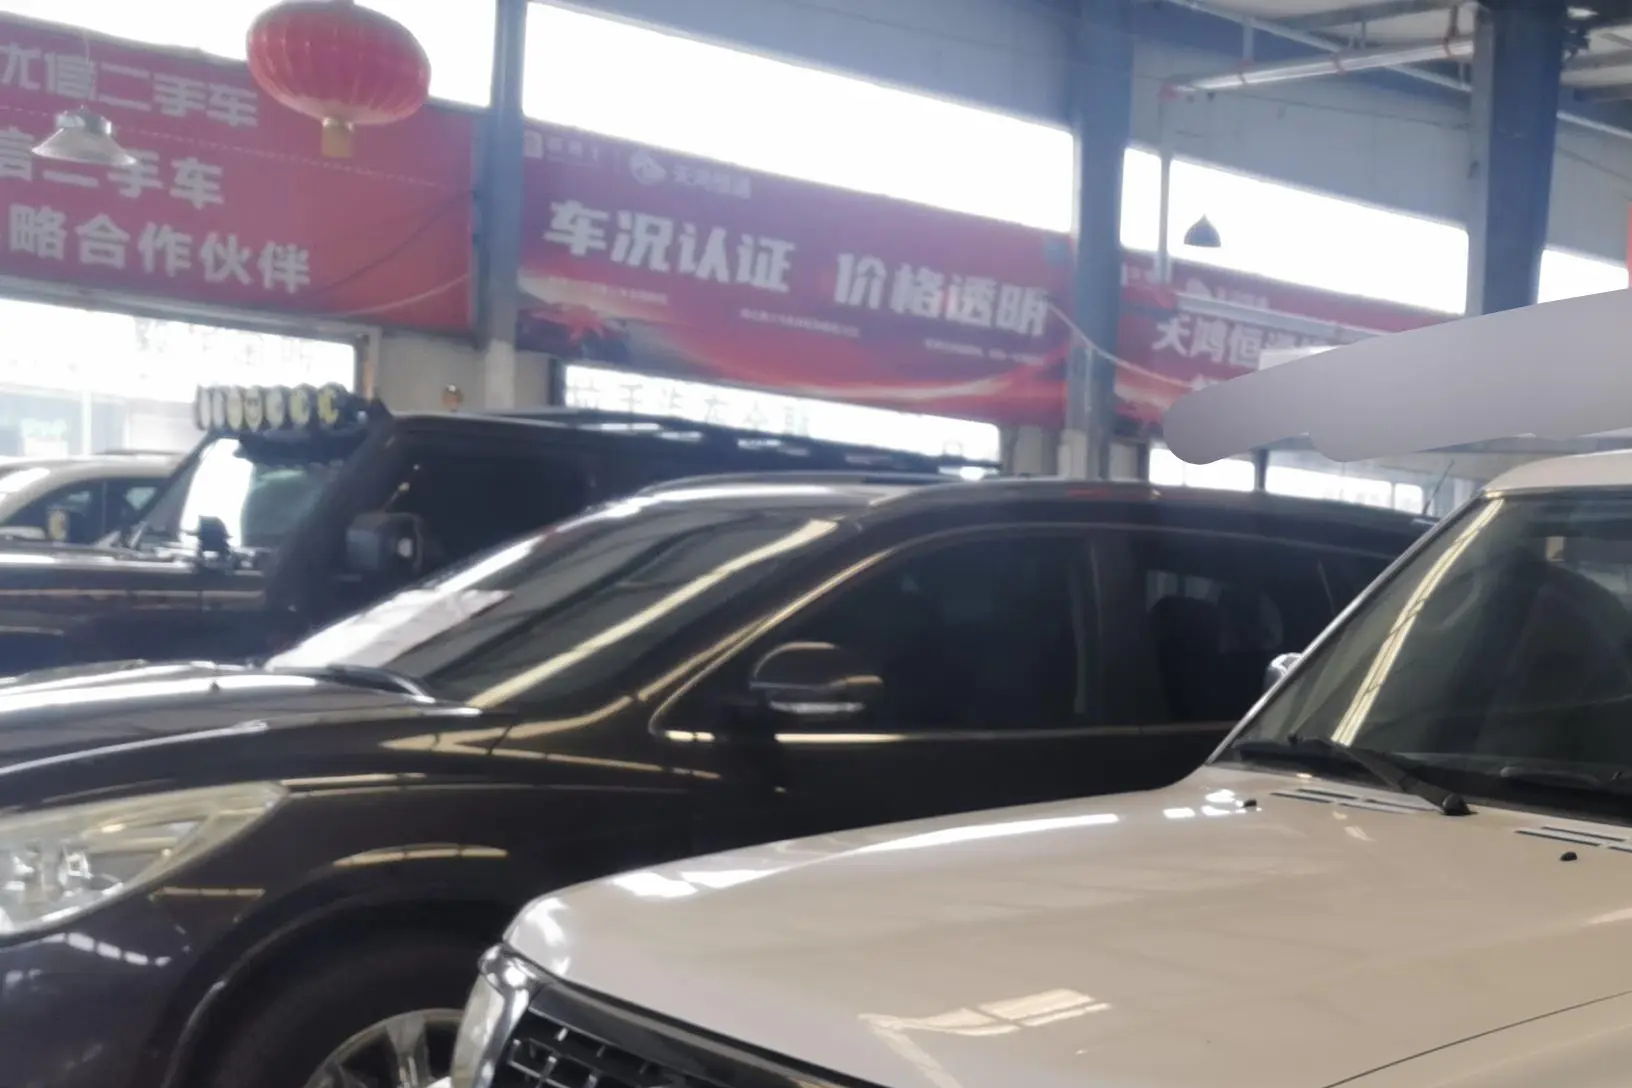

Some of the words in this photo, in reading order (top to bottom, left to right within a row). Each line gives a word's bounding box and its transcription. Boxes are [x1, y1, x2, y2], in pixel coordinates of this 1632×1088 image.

[9, 204, 311, 294] 略合作伙伴
[542, 199, 795, 293] 车况认证
[833, 252, 1049, 336] 价格透明
